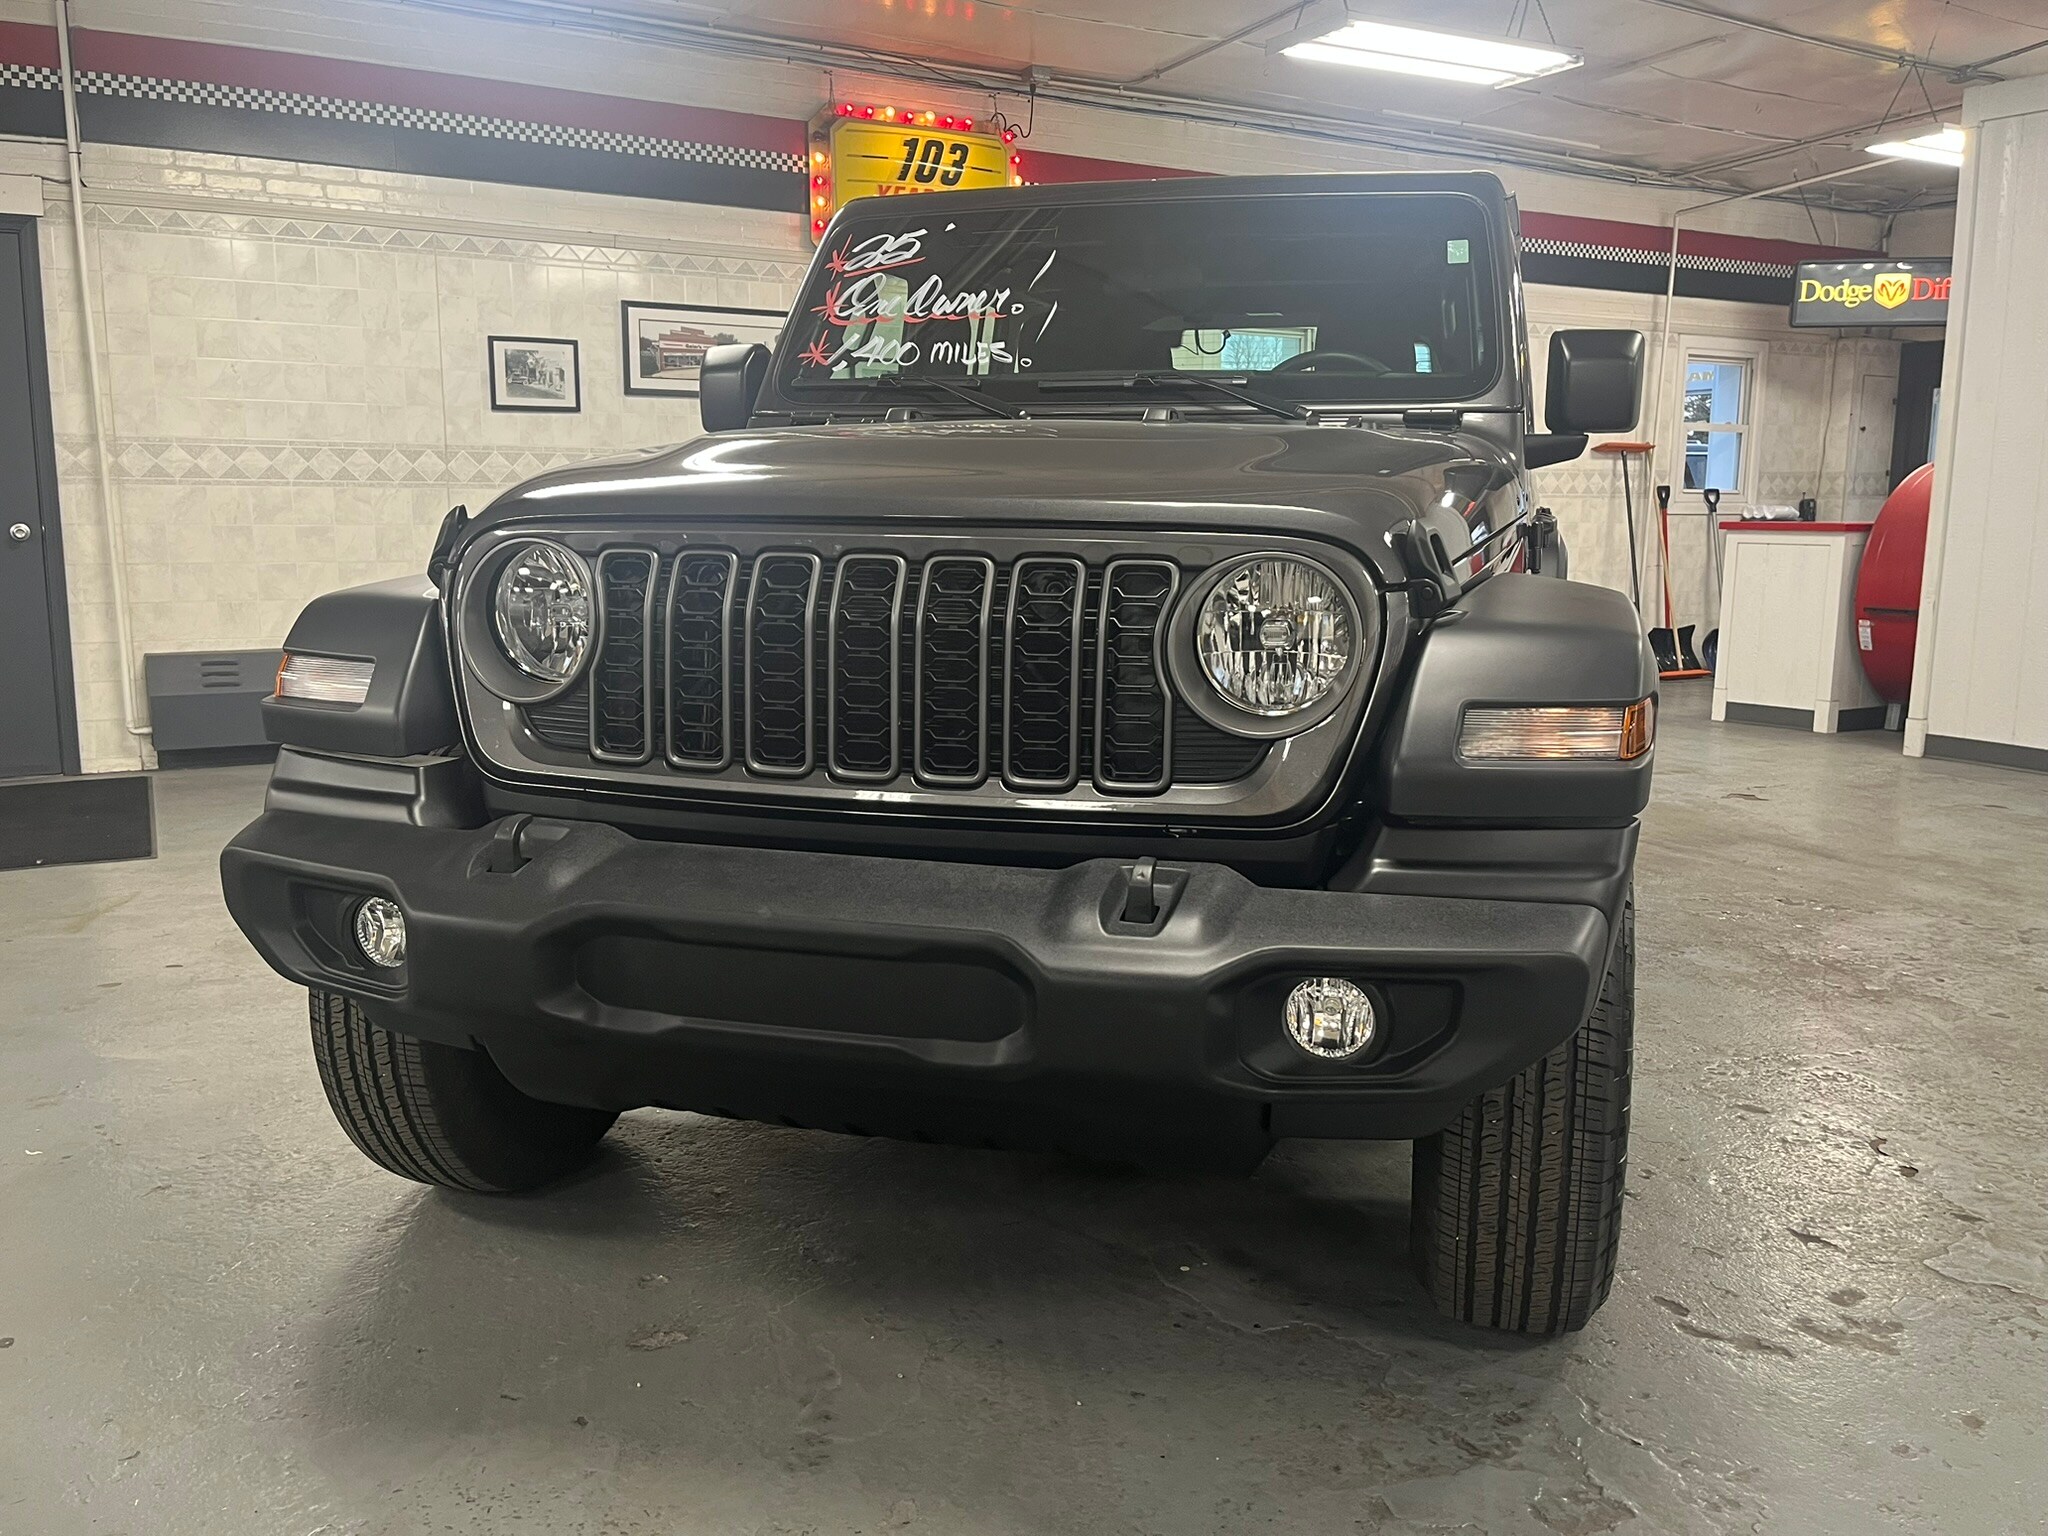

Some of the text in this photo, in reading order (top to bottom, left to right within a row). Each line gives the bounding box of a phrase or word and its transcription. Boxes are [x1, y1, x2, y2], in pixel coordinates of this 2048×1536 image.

[897, 137, 969, 187] 103
[833, 272, 902, 317] One
[1798, 278, 1873, 308] Dodge
